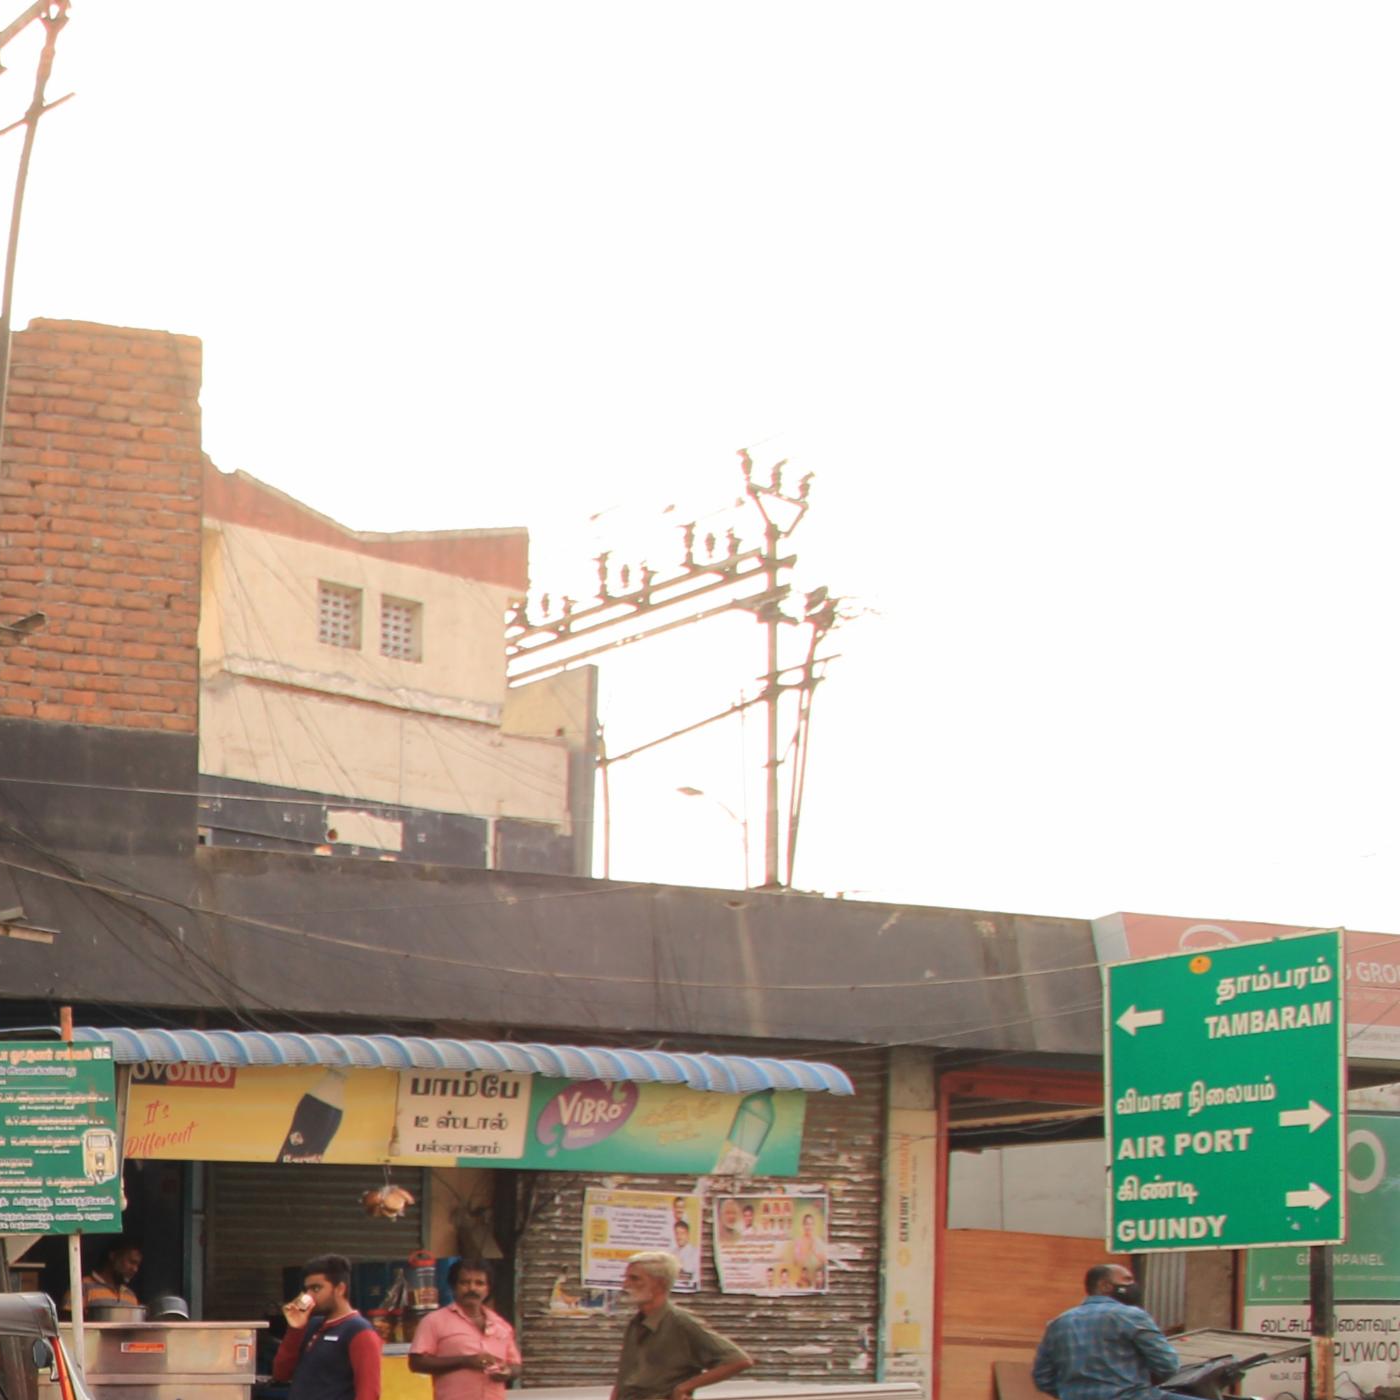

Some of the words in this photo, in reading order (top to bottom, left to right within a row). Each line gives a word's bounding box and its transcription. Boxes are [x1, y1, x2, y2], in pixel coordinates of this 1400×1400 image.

[1216, 956, 1333, 1004] தாம்பரம்
[1205, 1001, 1333, 1040] TAMBARAM
[131, 1061, 232, 1084] ovonto
[410, 1072, 520, 1100] பாம்பே
[1116, 1083, 1182, 1116] விமான
[1187, 1075, 1277, 1117] நிலையம்
[143, 1099, 170, 1127] It's
[436, 1111, 508, 1131] ஸ்டால்
[415, 1140, 502, 1155] பல்லாவரம்
[1118, 1134, 1166, 1161] AIR
[1174, 1127, 1253, 1156] PORT
[1116, 1174, 1198, 1205] கிண்டி
[899, 1196, 910, 1242] CENTURY
[1117, 1214, 1227, 1243] GUINDY
[1295, 1253, 1385, 1266] GRNPANEL
